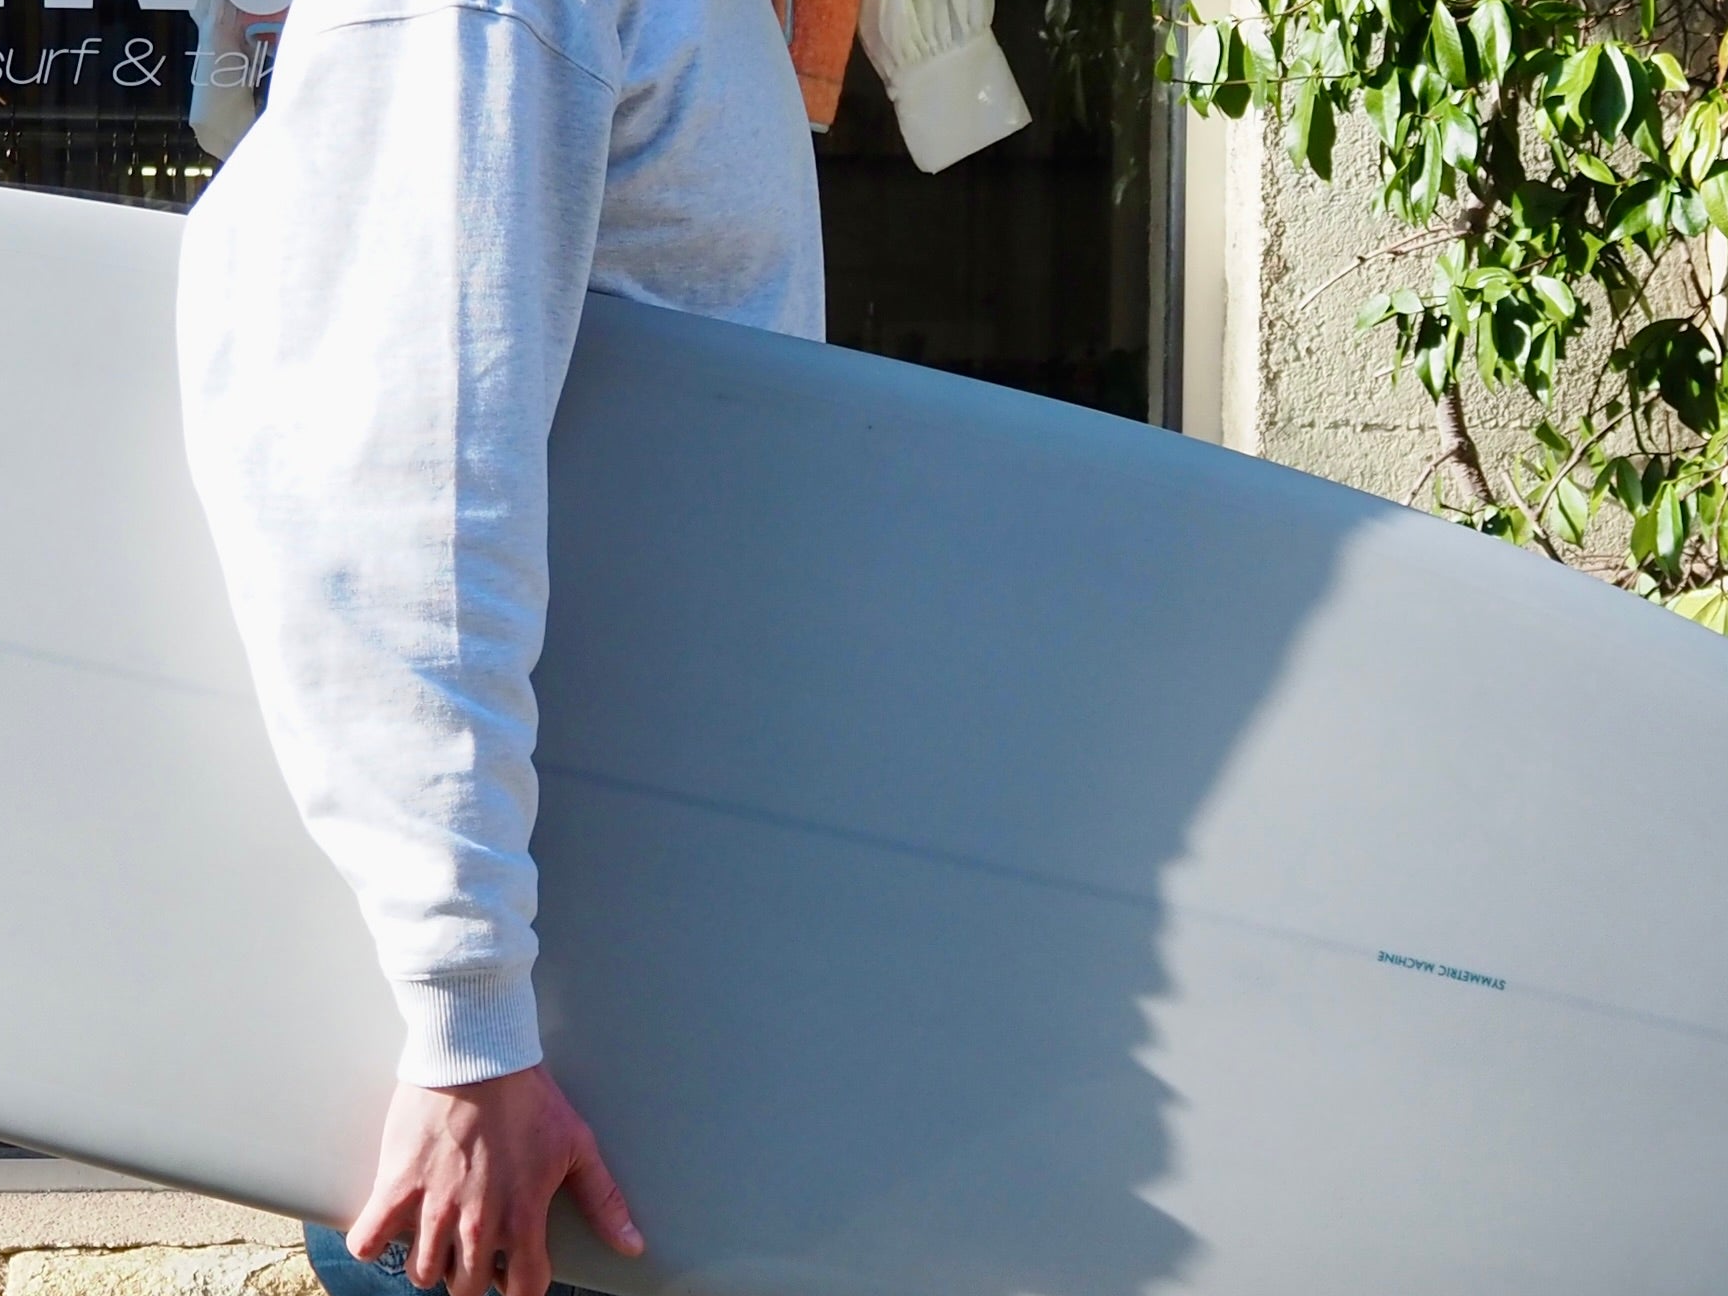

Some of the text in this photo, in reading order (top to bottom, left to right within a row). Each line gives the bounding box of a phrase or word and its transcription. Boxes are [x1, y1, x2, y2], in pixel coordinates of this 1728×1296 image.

[113, 38, 166, 87] &
[1377, 950, 1507, 991] SYMMETRIC MACHINE
